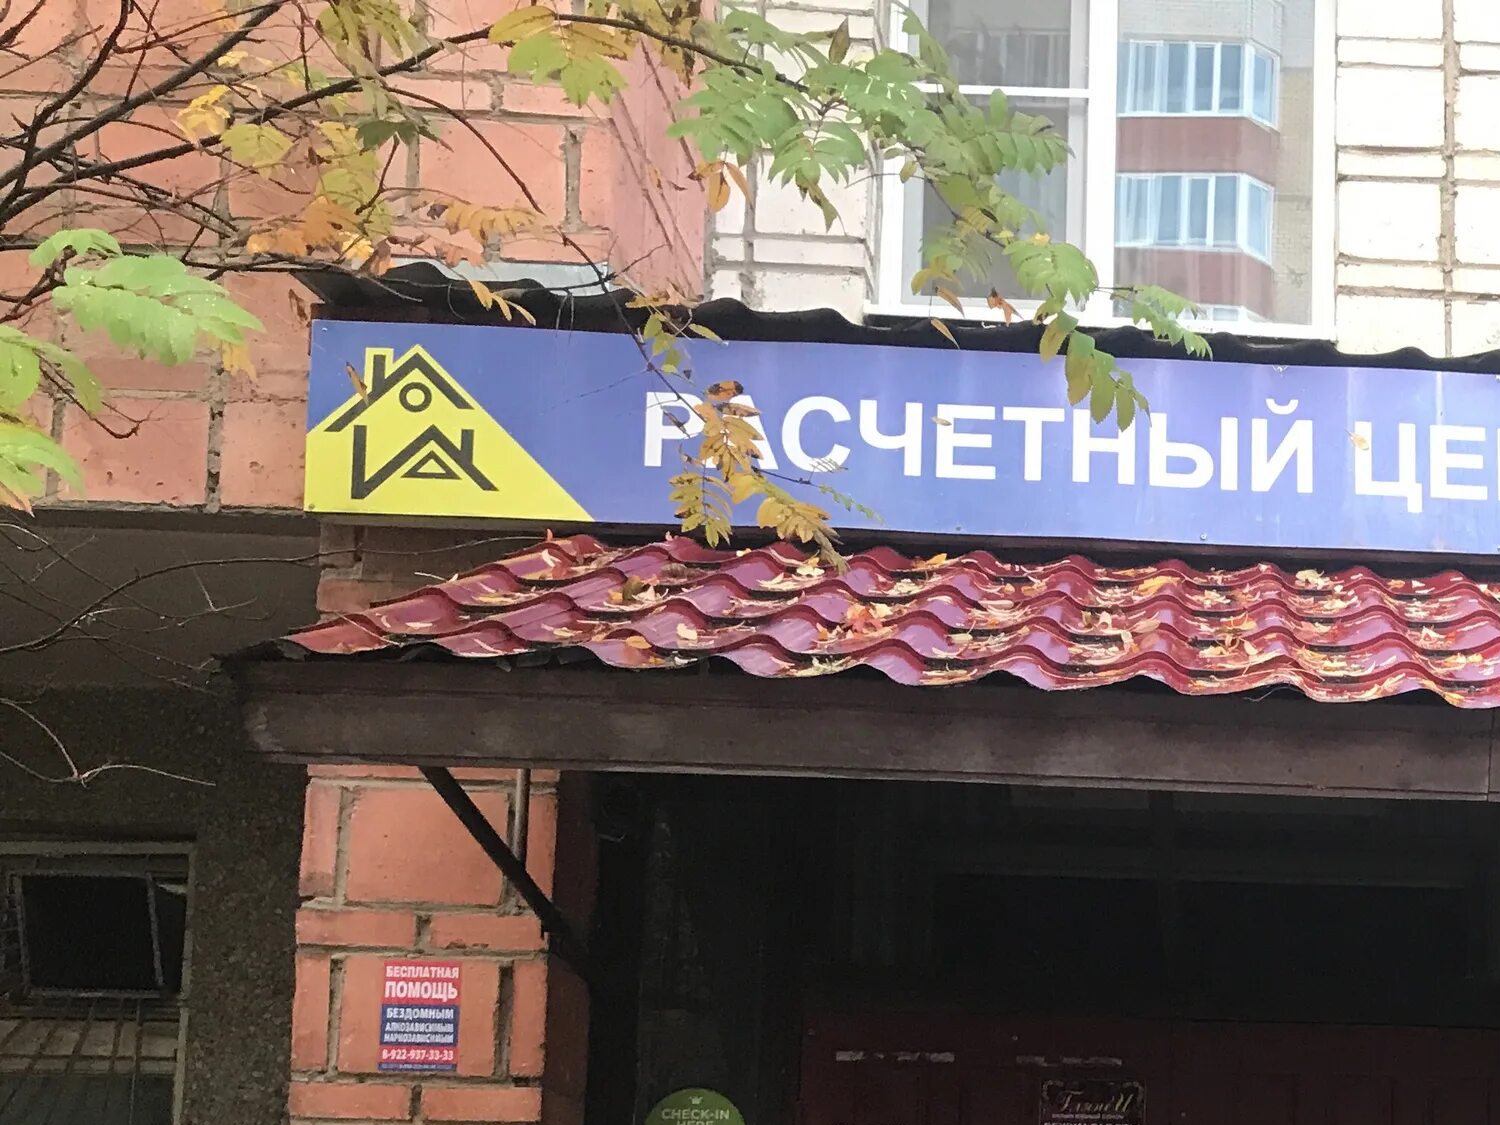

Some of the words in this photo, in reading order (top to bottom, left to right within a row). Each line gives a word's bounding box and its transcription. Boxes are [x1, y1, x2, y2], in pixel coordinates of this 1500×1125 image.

[644, 391, 1314, 494] РАСЧЕТНЫЙ
[386, 966, 459, 979] БЕСПЛАТНАЯ
[384, 981, 458, 1002] ПОМОЩЬ
[386, 1008, 454, 1020] БЕЗДОМНЫМ
[382, 1049, 454, 1060] 8-922-937-33-33
[661, 1108, 730, 1120] CHECK-IN
